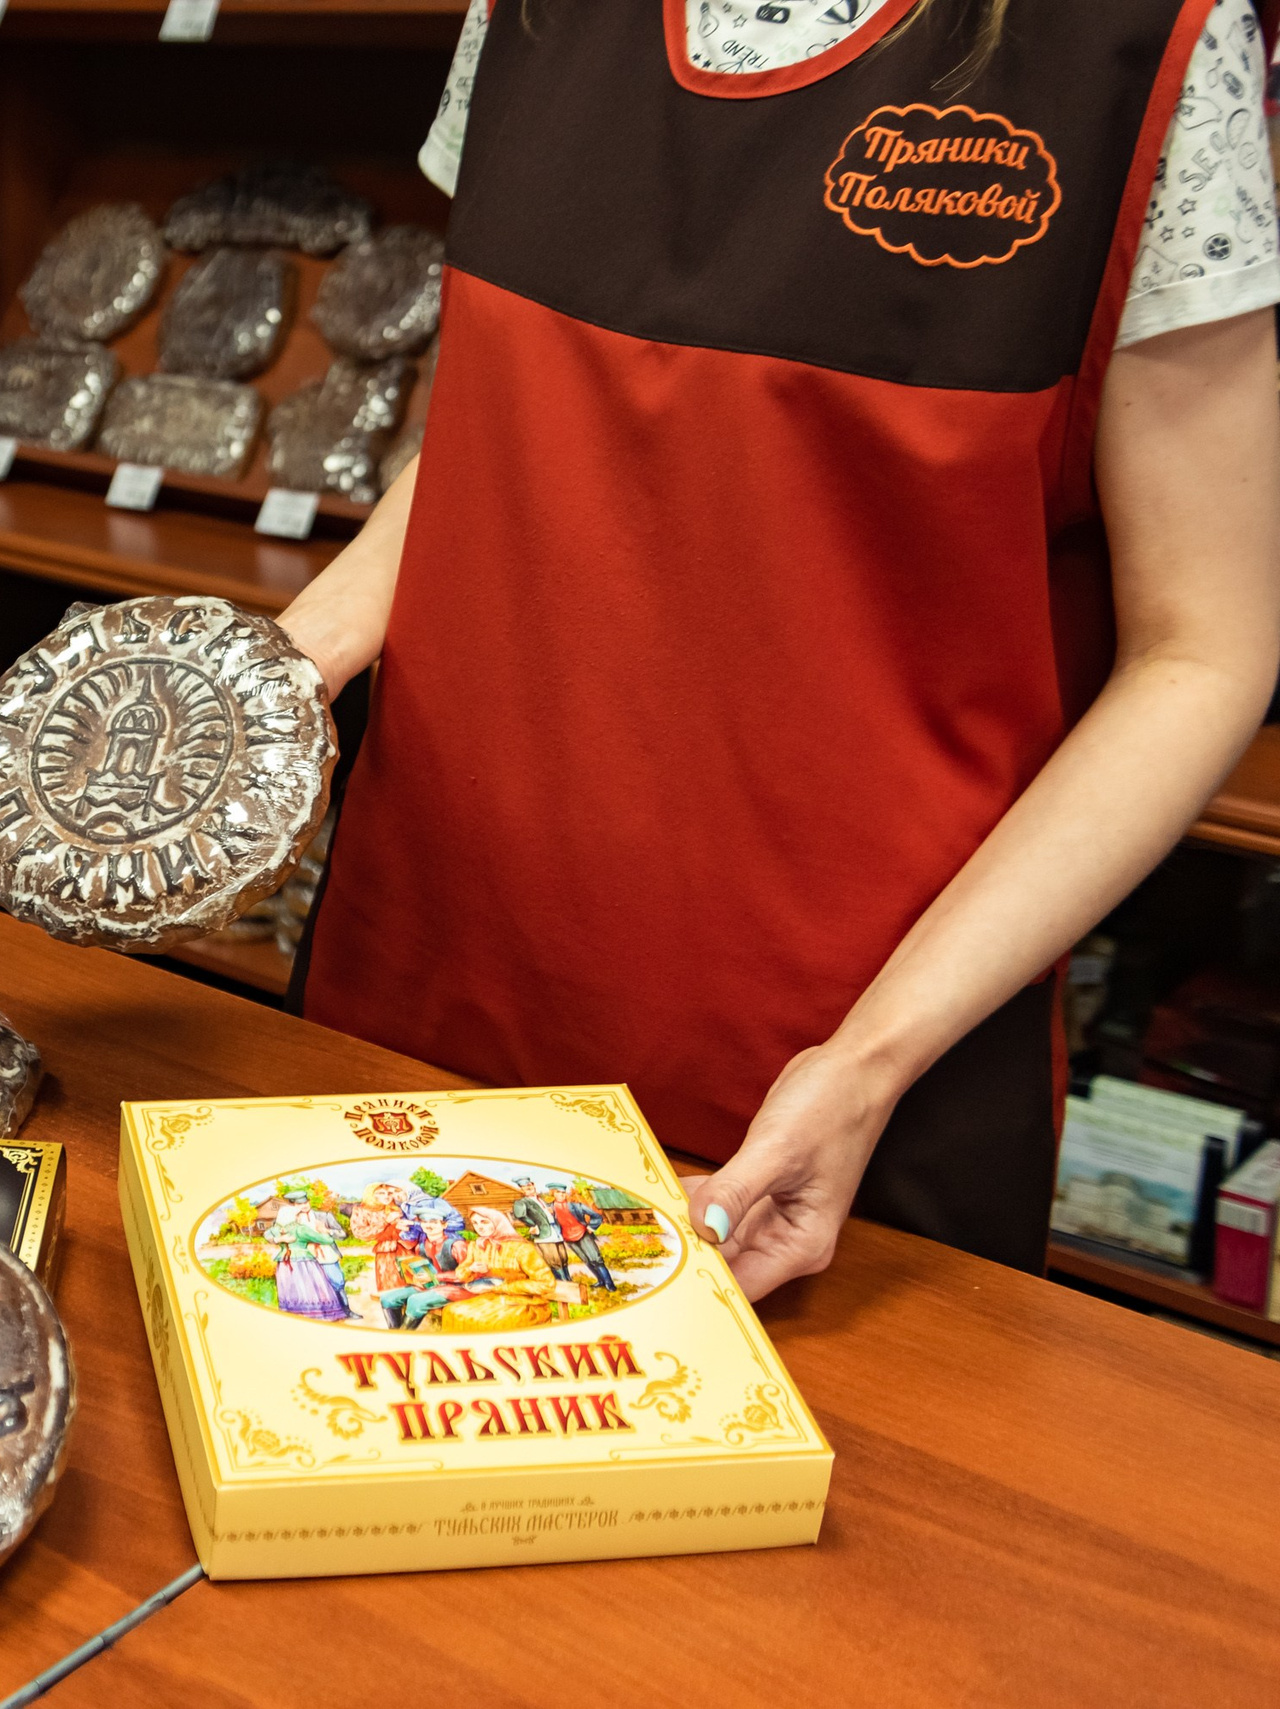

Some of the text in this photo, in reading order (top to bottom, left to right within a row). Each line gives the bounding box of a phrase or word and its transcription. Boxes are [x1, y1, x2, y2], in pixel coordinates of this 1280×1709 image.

[721, 39, 770, 70] TREND
[864, 126, 1030, 174] Пряники
[838, 171, 1042, 224] Поляковой
[344, 1098, 434, 1121] ПРЯНИКИ
[353, 1125, 439, 1151] ПОЛЯКОВОЙ
[337, 1335, 644, 1399] ТУЛЬСКИЙ
[389, 1392, 632, 1440] ПРЯНИК
[434, 1514, 522, 1537] ТУЛЬСКИХ
